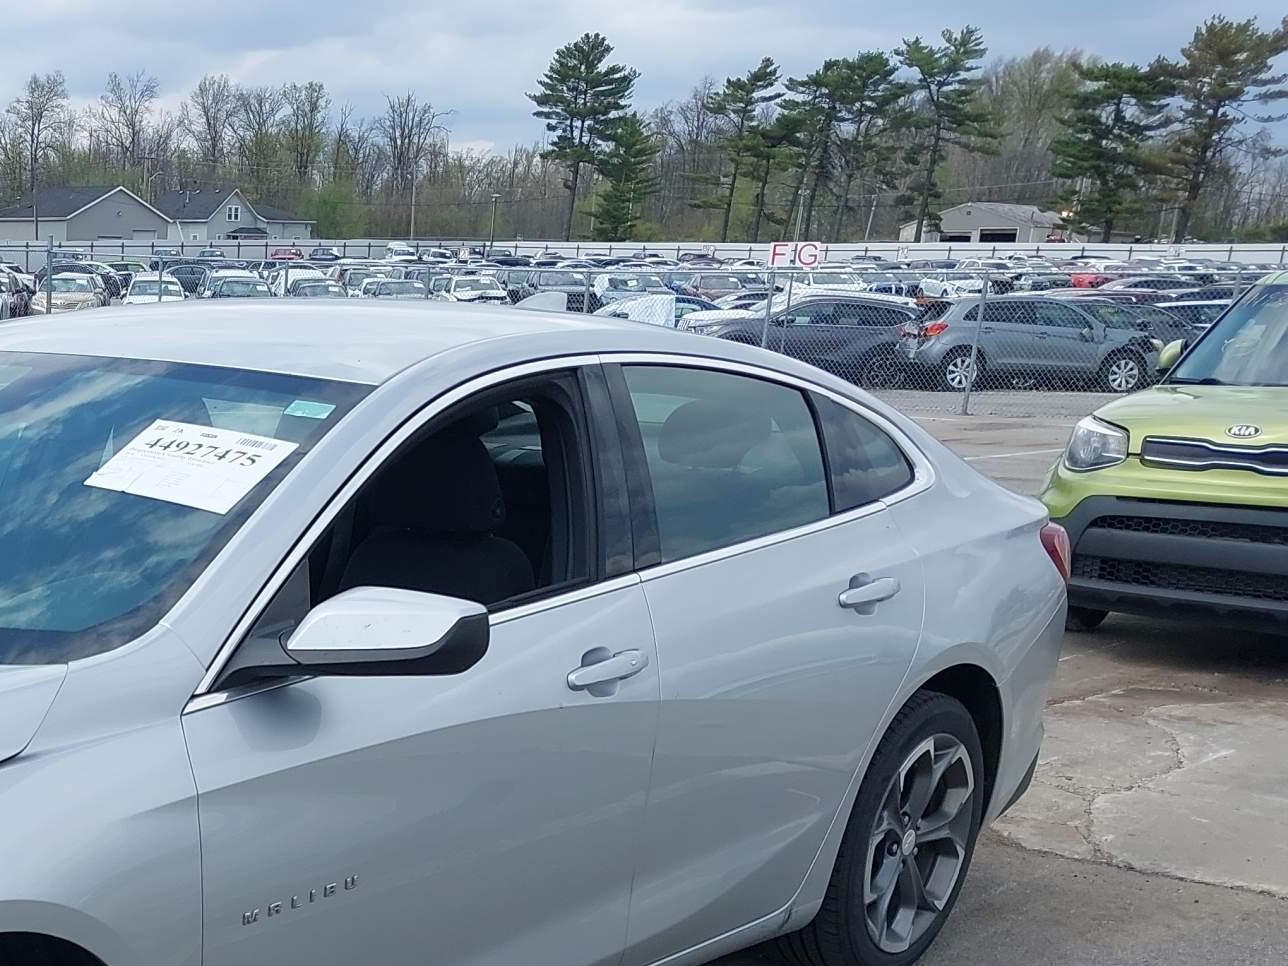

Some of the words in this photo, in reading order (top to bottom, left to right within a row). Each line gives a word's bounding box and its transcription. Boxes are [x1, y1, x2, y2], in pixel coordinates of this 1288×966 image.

[1230, 425, 1256, 436] KIA
[144, 437, 262, 467] 44927475
[241, 874, 359, 926] MALIBU
